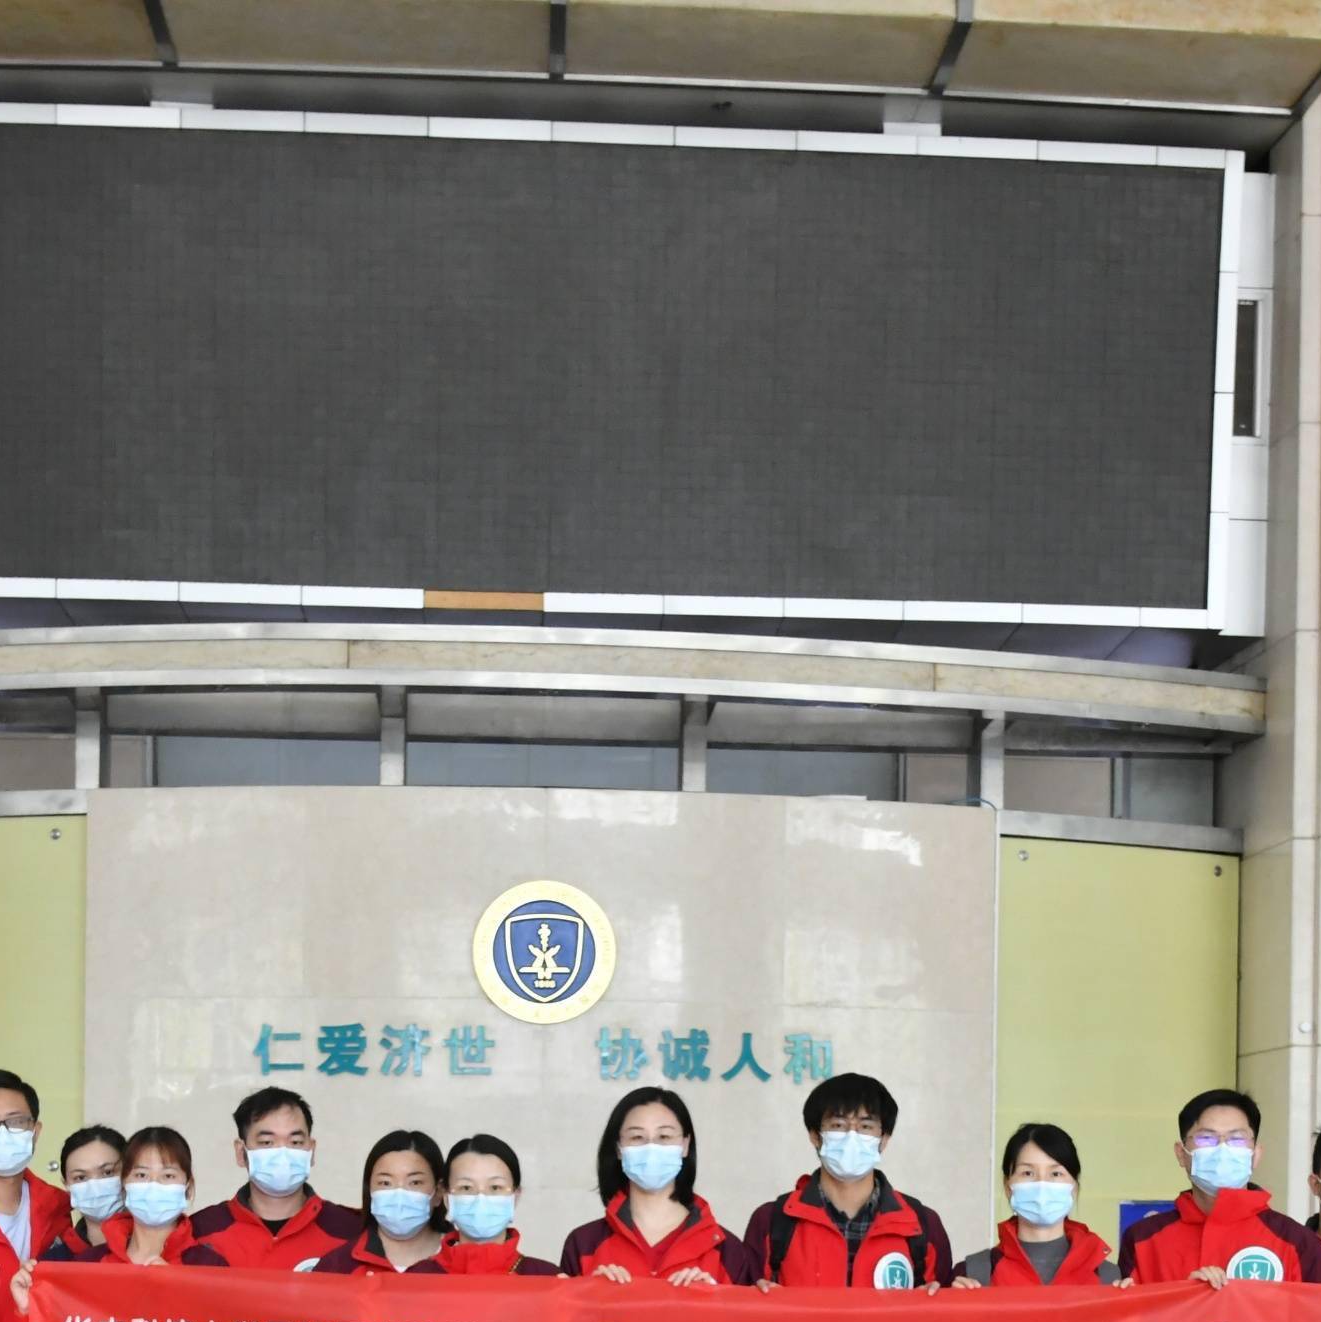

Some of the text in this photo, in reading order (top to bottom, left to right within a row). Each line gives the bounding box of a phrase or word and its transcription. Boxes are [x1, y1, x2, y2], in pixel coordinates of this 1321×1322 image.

[253, 1023, 833, 1085] 仁爱济世 协诚人和
